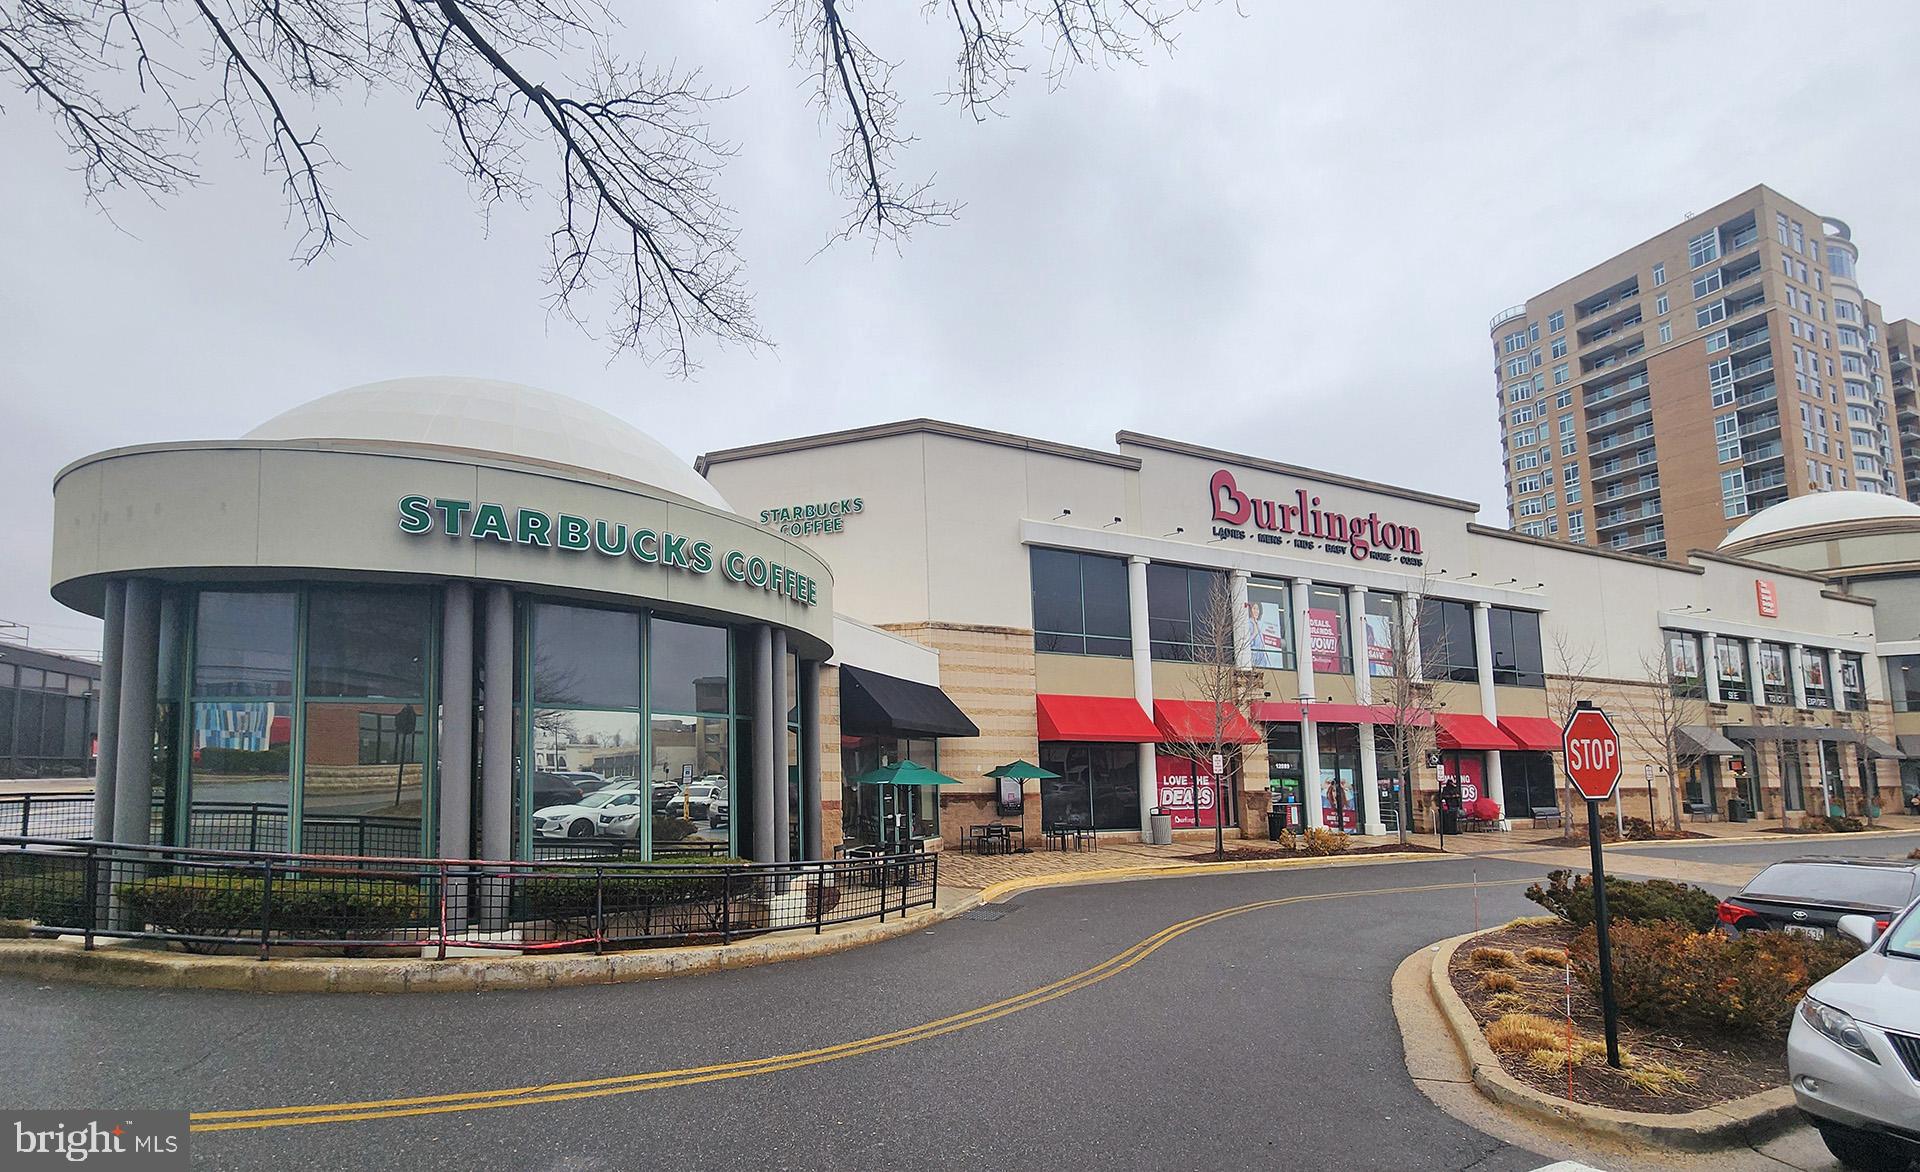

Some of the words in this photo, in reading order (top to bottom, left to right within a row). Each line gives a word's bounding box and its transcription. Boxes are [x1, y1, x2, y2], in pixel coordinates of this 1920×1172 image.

[760, 498, 864, 524] STARBUCKS
[1210, 469, 1424, 561] Burlington
[780, 518, 844, 537] COFFEE
[398, 495, 714, 574] STARBUCKS
[721, 550, 817, 607] COFFEE
[1570, 738, 1615, 771] STOP
[1163, 775, 1188, 786] LOVE
[1161, 788, 1212, 806] DEAS
